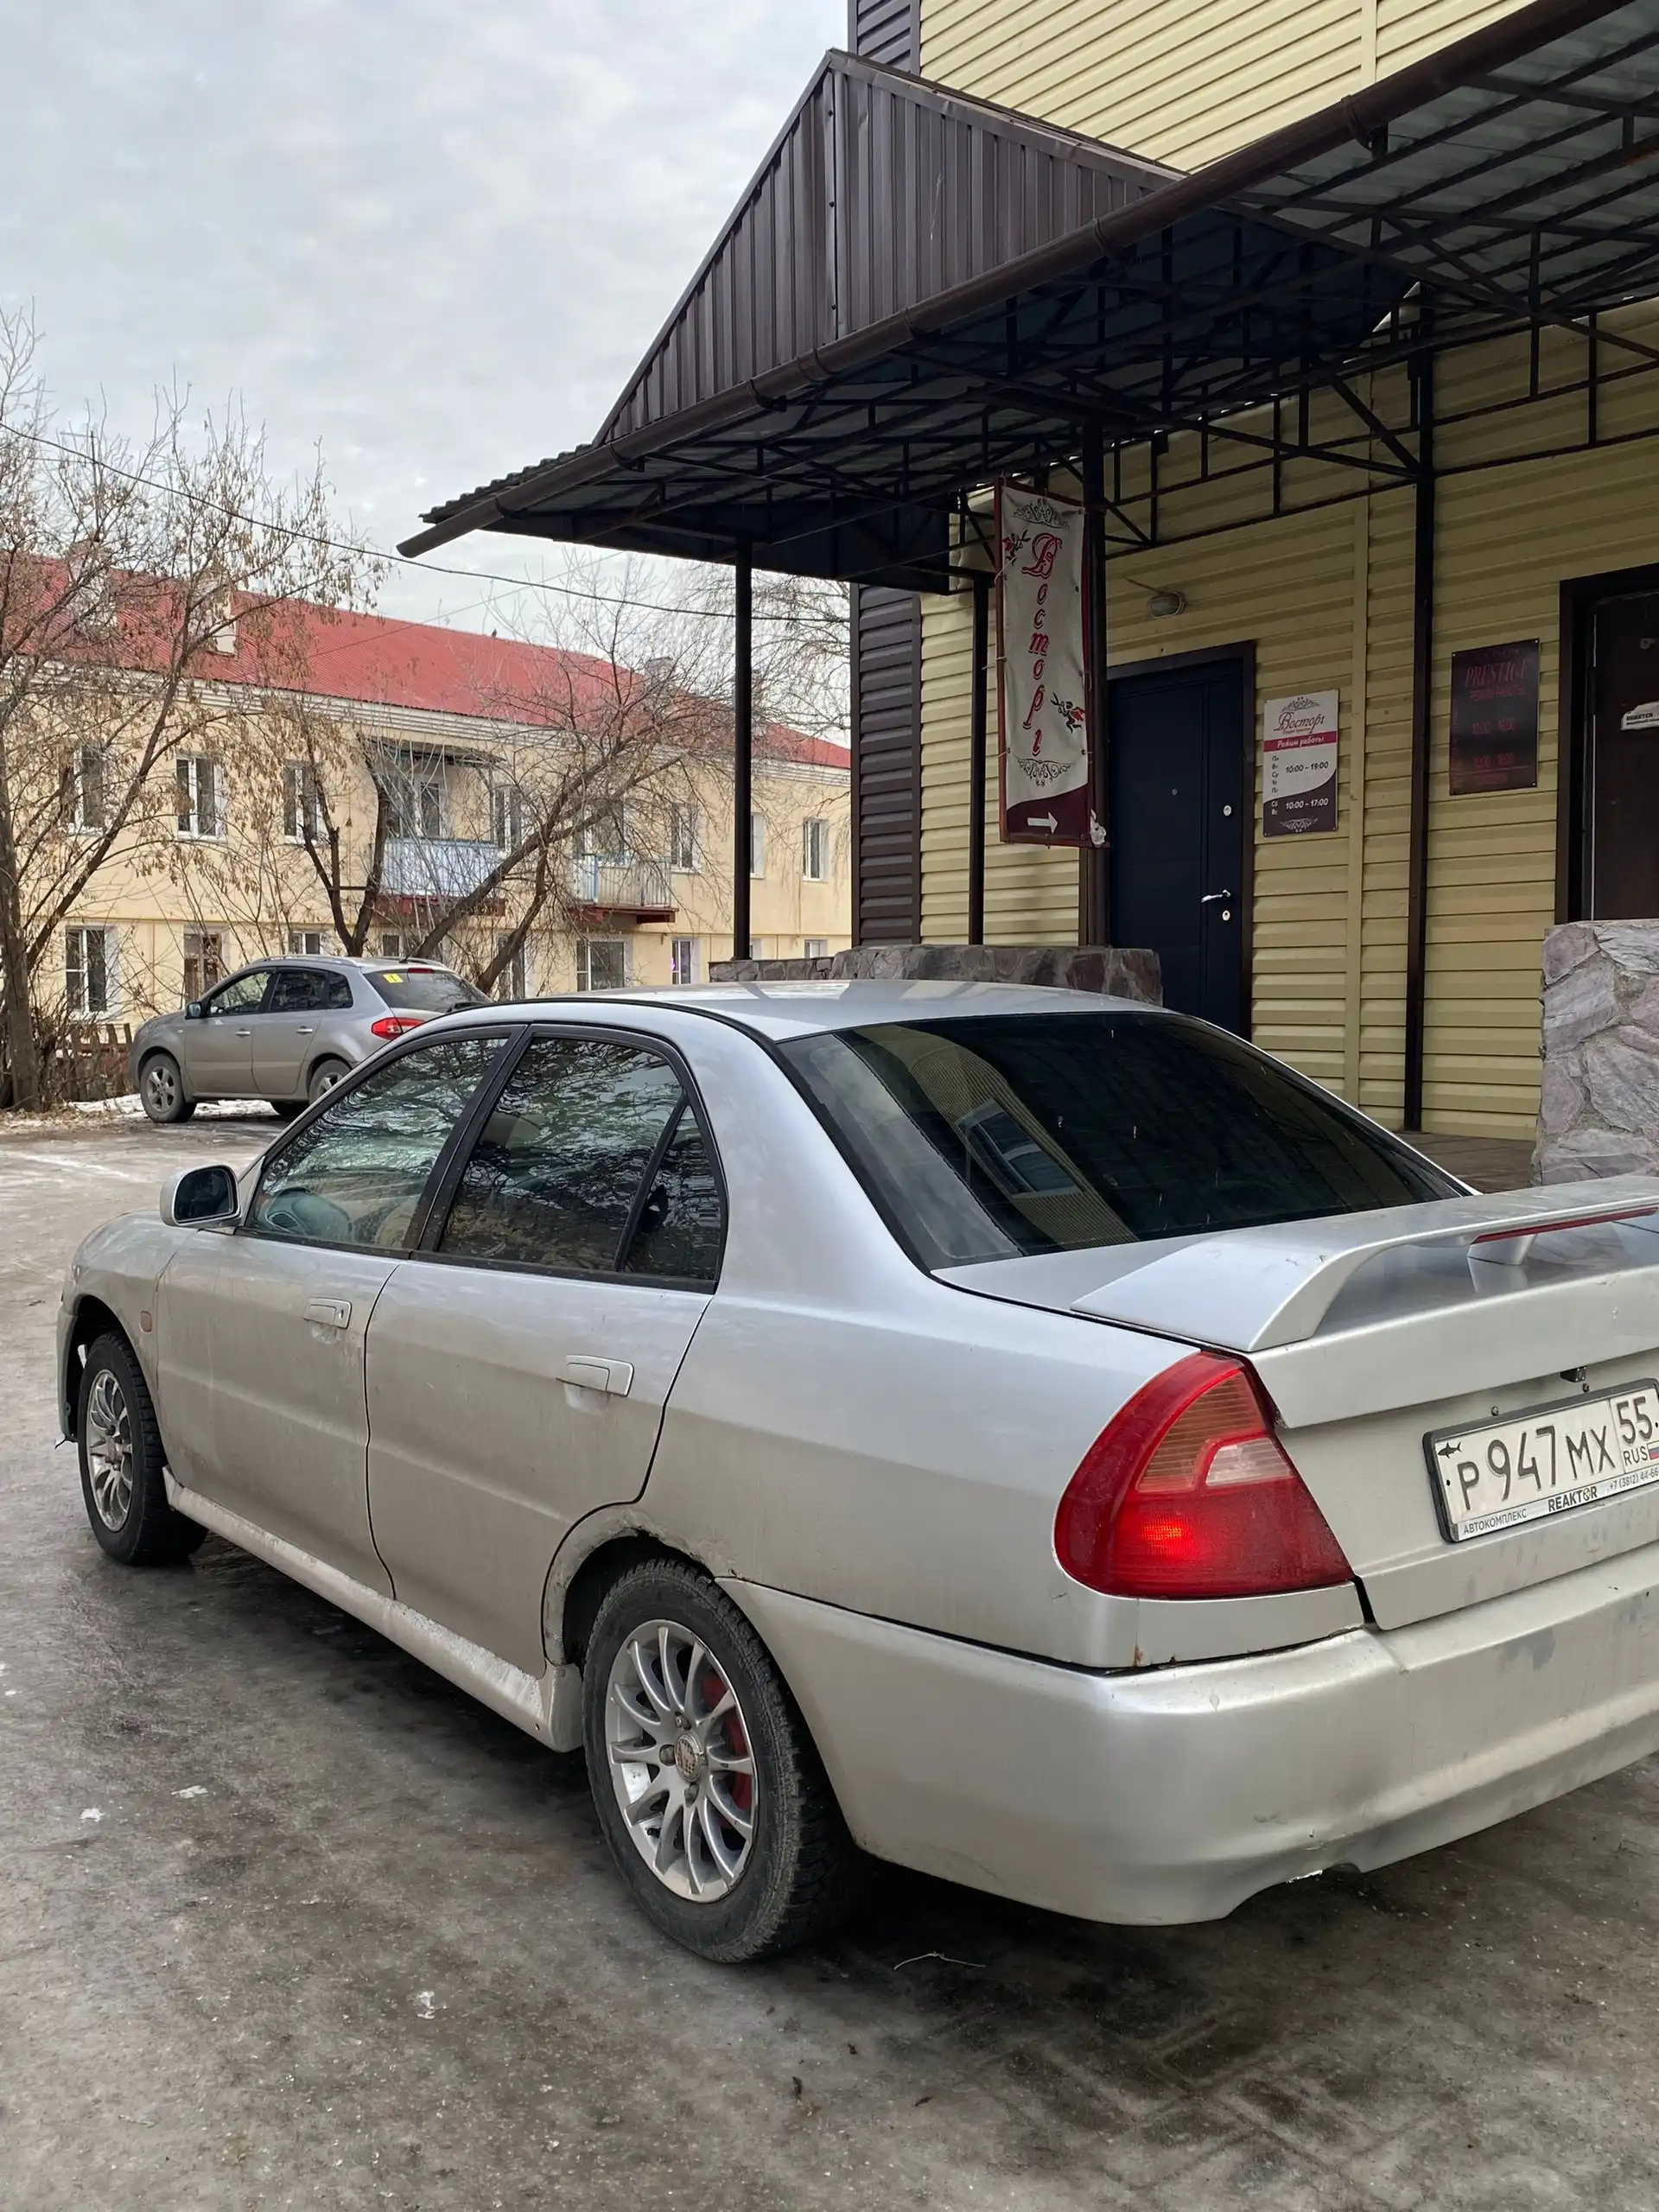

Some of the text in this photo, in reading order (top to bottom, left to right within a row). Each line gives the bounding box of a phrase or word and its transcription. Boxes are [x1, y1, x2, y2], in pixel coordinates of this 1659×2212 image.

[1273, 711, 1325, 734] Восторг
[1277, 736, 1325, 748] Режим работы
[1286, 764, 1304, 773] 10:00
[1311, 761, 1329, 771] 19:00
[1286, 800, 1304, 810] 10:00
[1310, 798, 1329, 807] 17:00
[1616, 1396, 1654, 1446] 55
[1623, 1446, 1649, 1466] RUS
[1548, 1485, 1598, 1512] REAKTOR
[1463, 1509, 1528, 1535] АВТОКОМПЛЕКС
